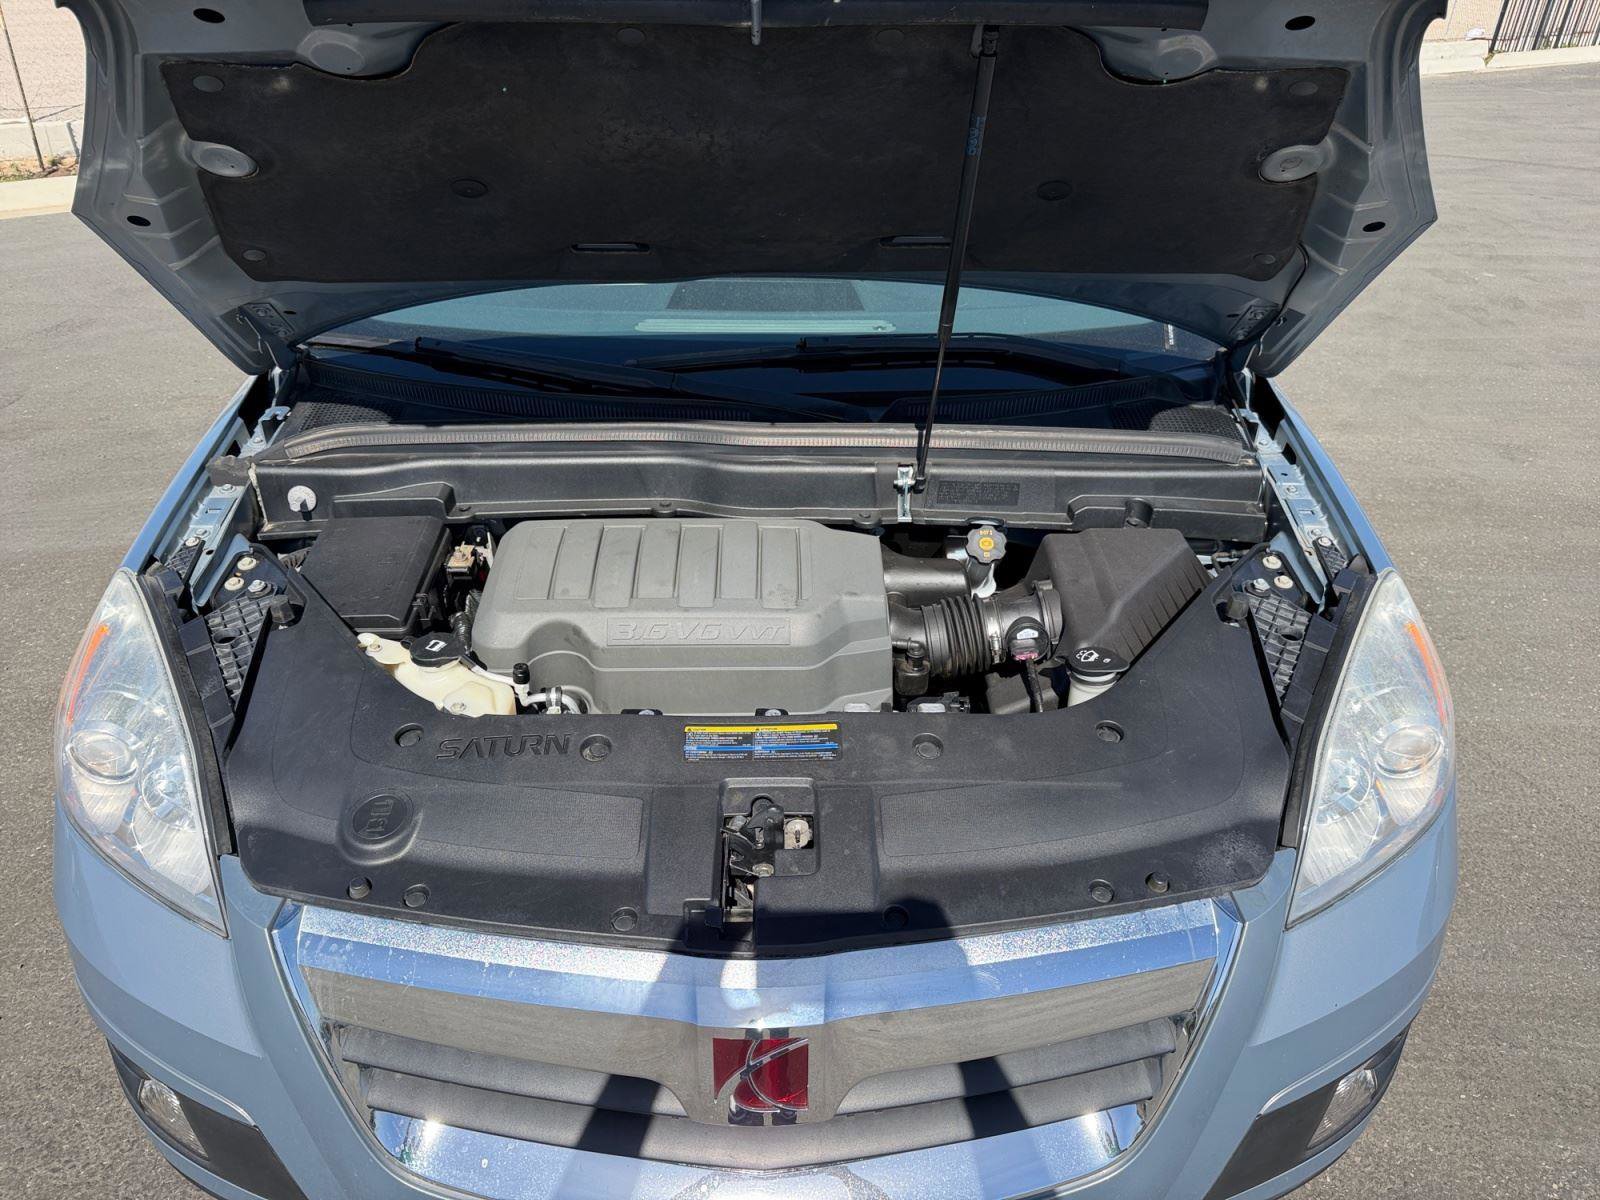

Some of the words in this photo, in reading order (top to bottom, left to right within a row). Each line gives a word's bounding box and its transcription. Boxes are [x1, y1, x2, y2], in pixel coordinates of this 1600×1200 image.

[612, 623, 669, 641] 3.6
[677, 623, 722, 641] V6
[728, 625, 785, 641] VVT
[436, 733, 572, 760] SATURN
